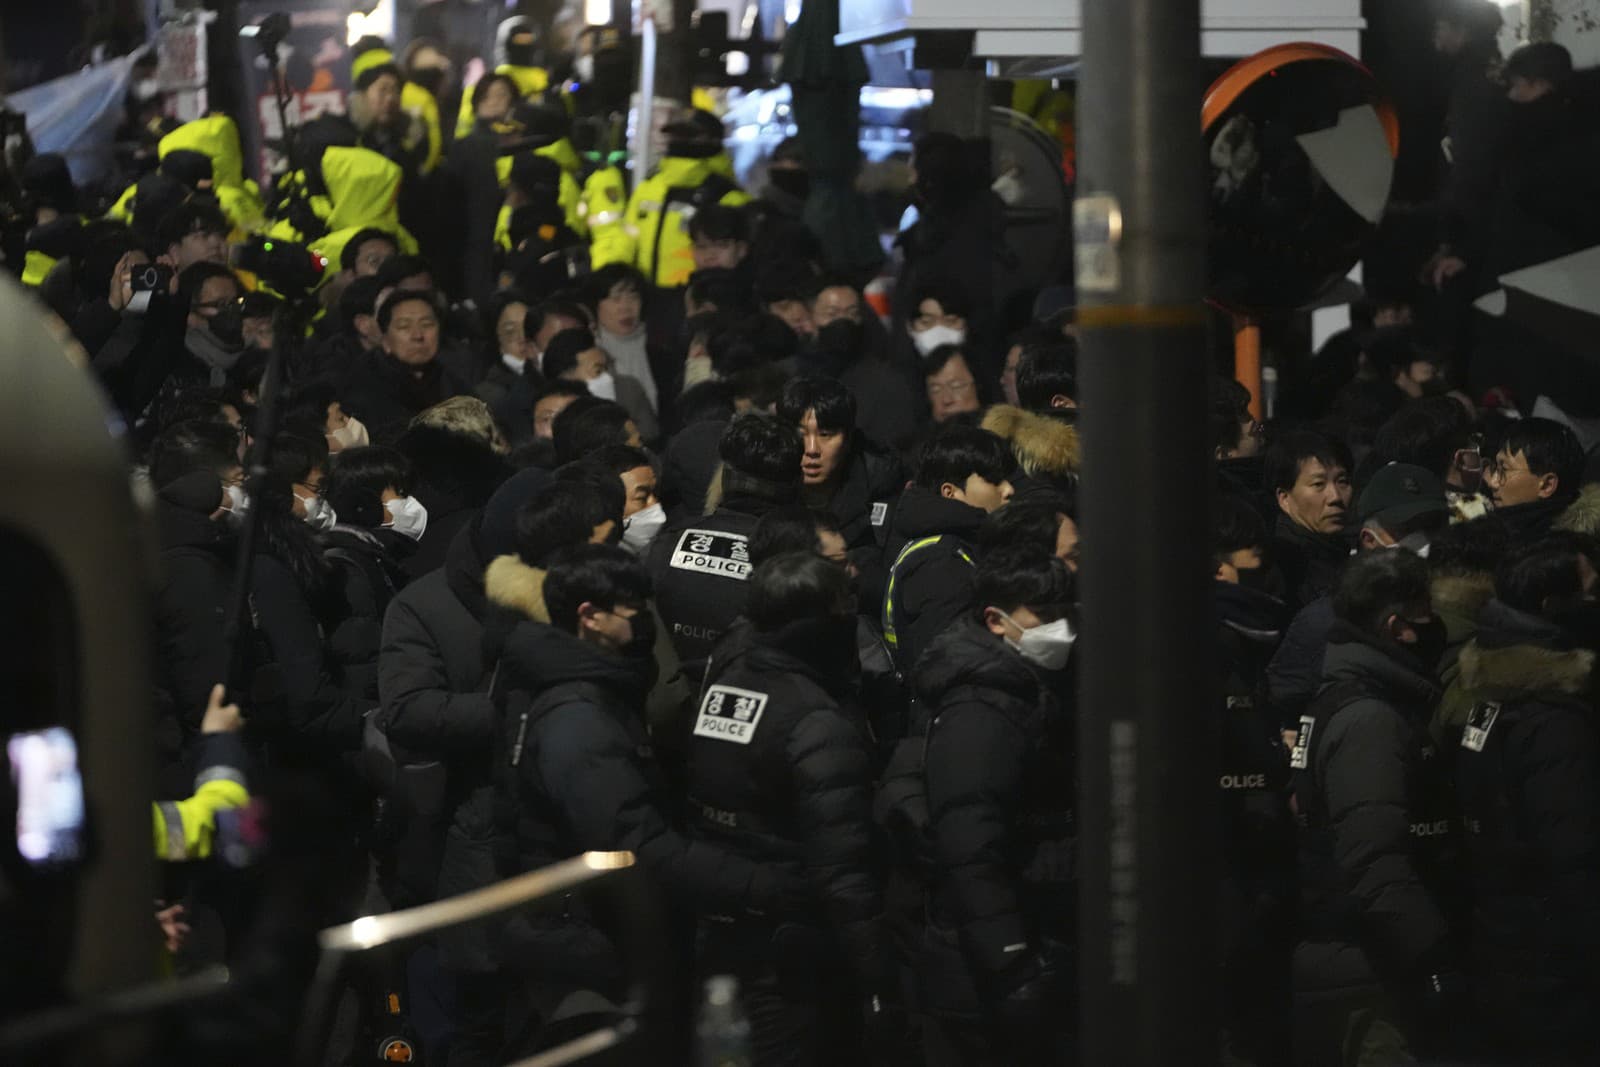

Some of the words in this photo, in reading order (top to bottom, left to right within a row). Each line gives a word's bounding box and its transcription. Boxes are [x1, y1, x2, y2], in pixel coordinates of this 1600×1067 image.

[682, 555, 747, 575] POLICE
[674, 622, 720, 641] POLIC
[702, 718, 748, 737] POLICE
[1219, 773, 1265, 789] OLICE
